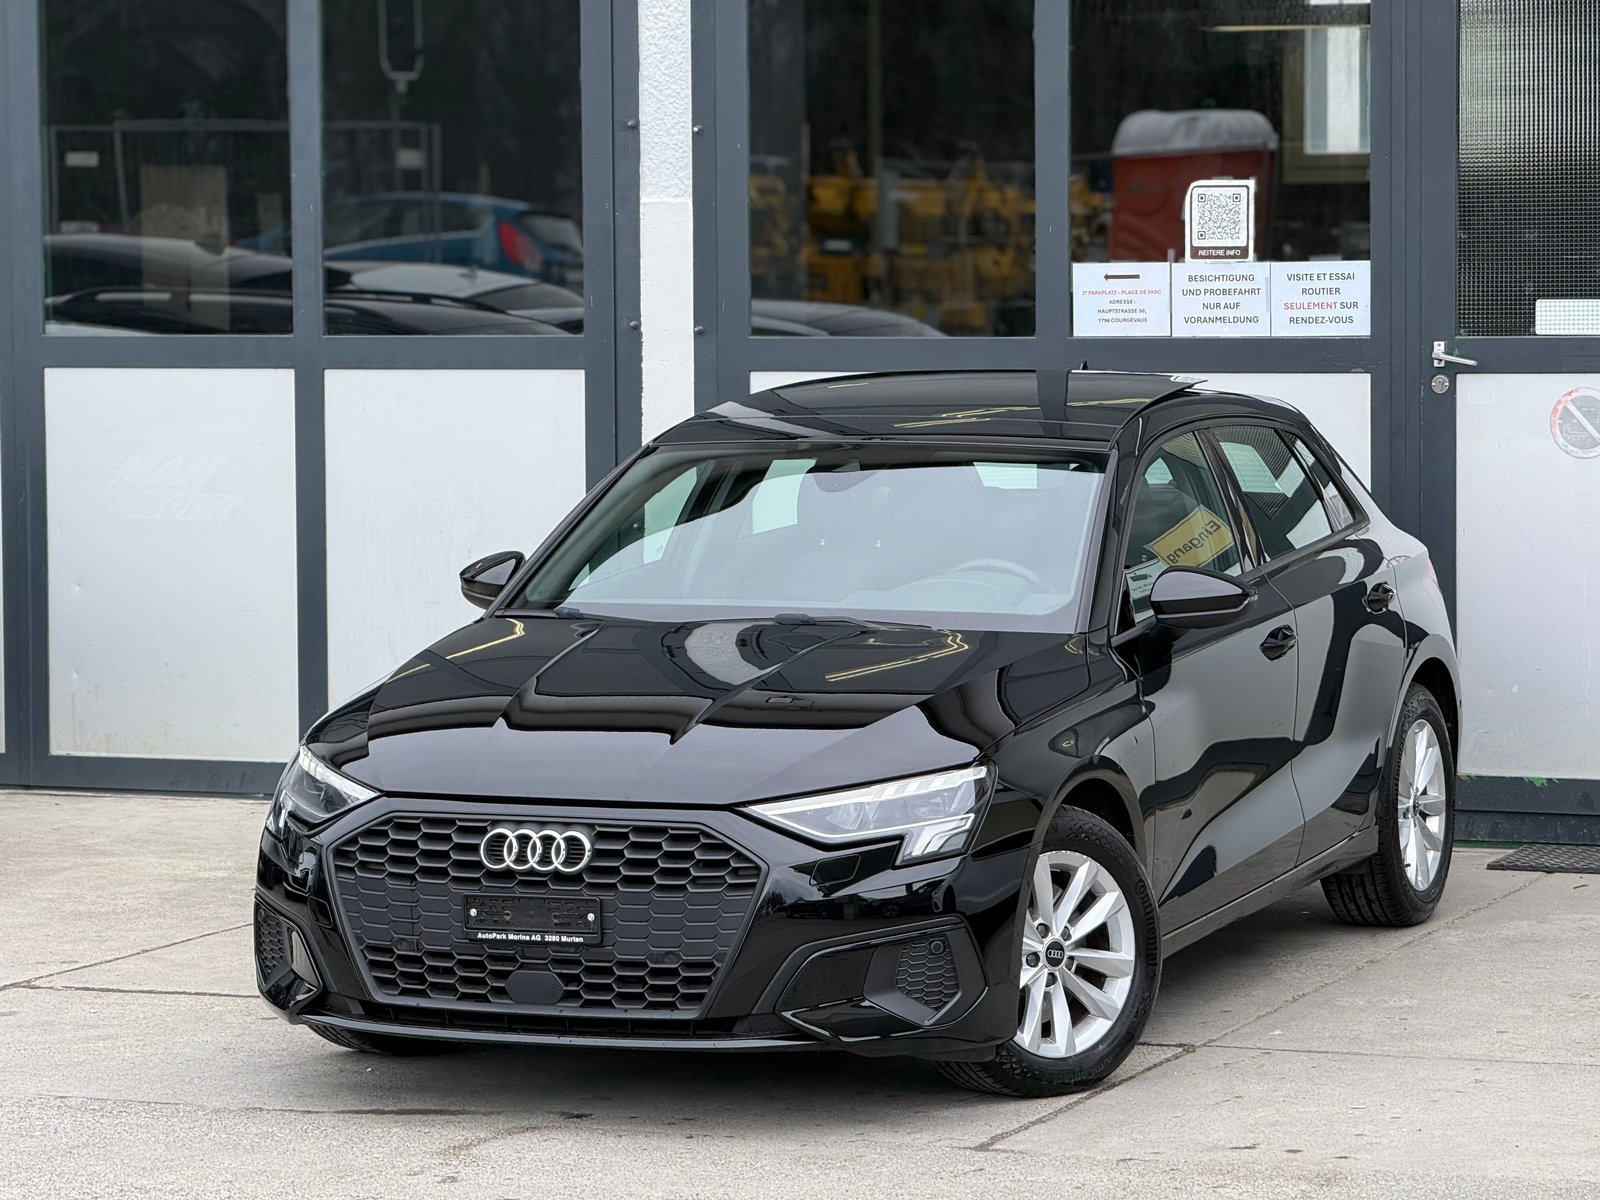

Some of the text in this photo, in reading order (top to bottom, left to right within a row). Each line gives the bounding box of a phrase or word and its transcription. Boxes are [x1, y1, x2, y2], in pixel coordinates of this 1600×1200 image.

[1188, 274, 1255, 282] BESICHTIGUNG
[1286, 272, 1355, 281] VISITE ET ESSAI
[1203, 288, 1262, 296] PROBEFAHRT
[1301, 287, 1341, 296] ROUTIER
[1202, 302, 1241, 310] NUR AUF
[1284, 301, 1359, 310] SEULEMENT SUR
[1184, 316, 1259, 324] VORANMELDUNG
[1289, 316, 1354, 324] RENDEZ-VOUS
[477, 932, 507, 940] AutoPark
[507, 933, 530, 941] Morina
[560, 935, 584, 943] Murten
